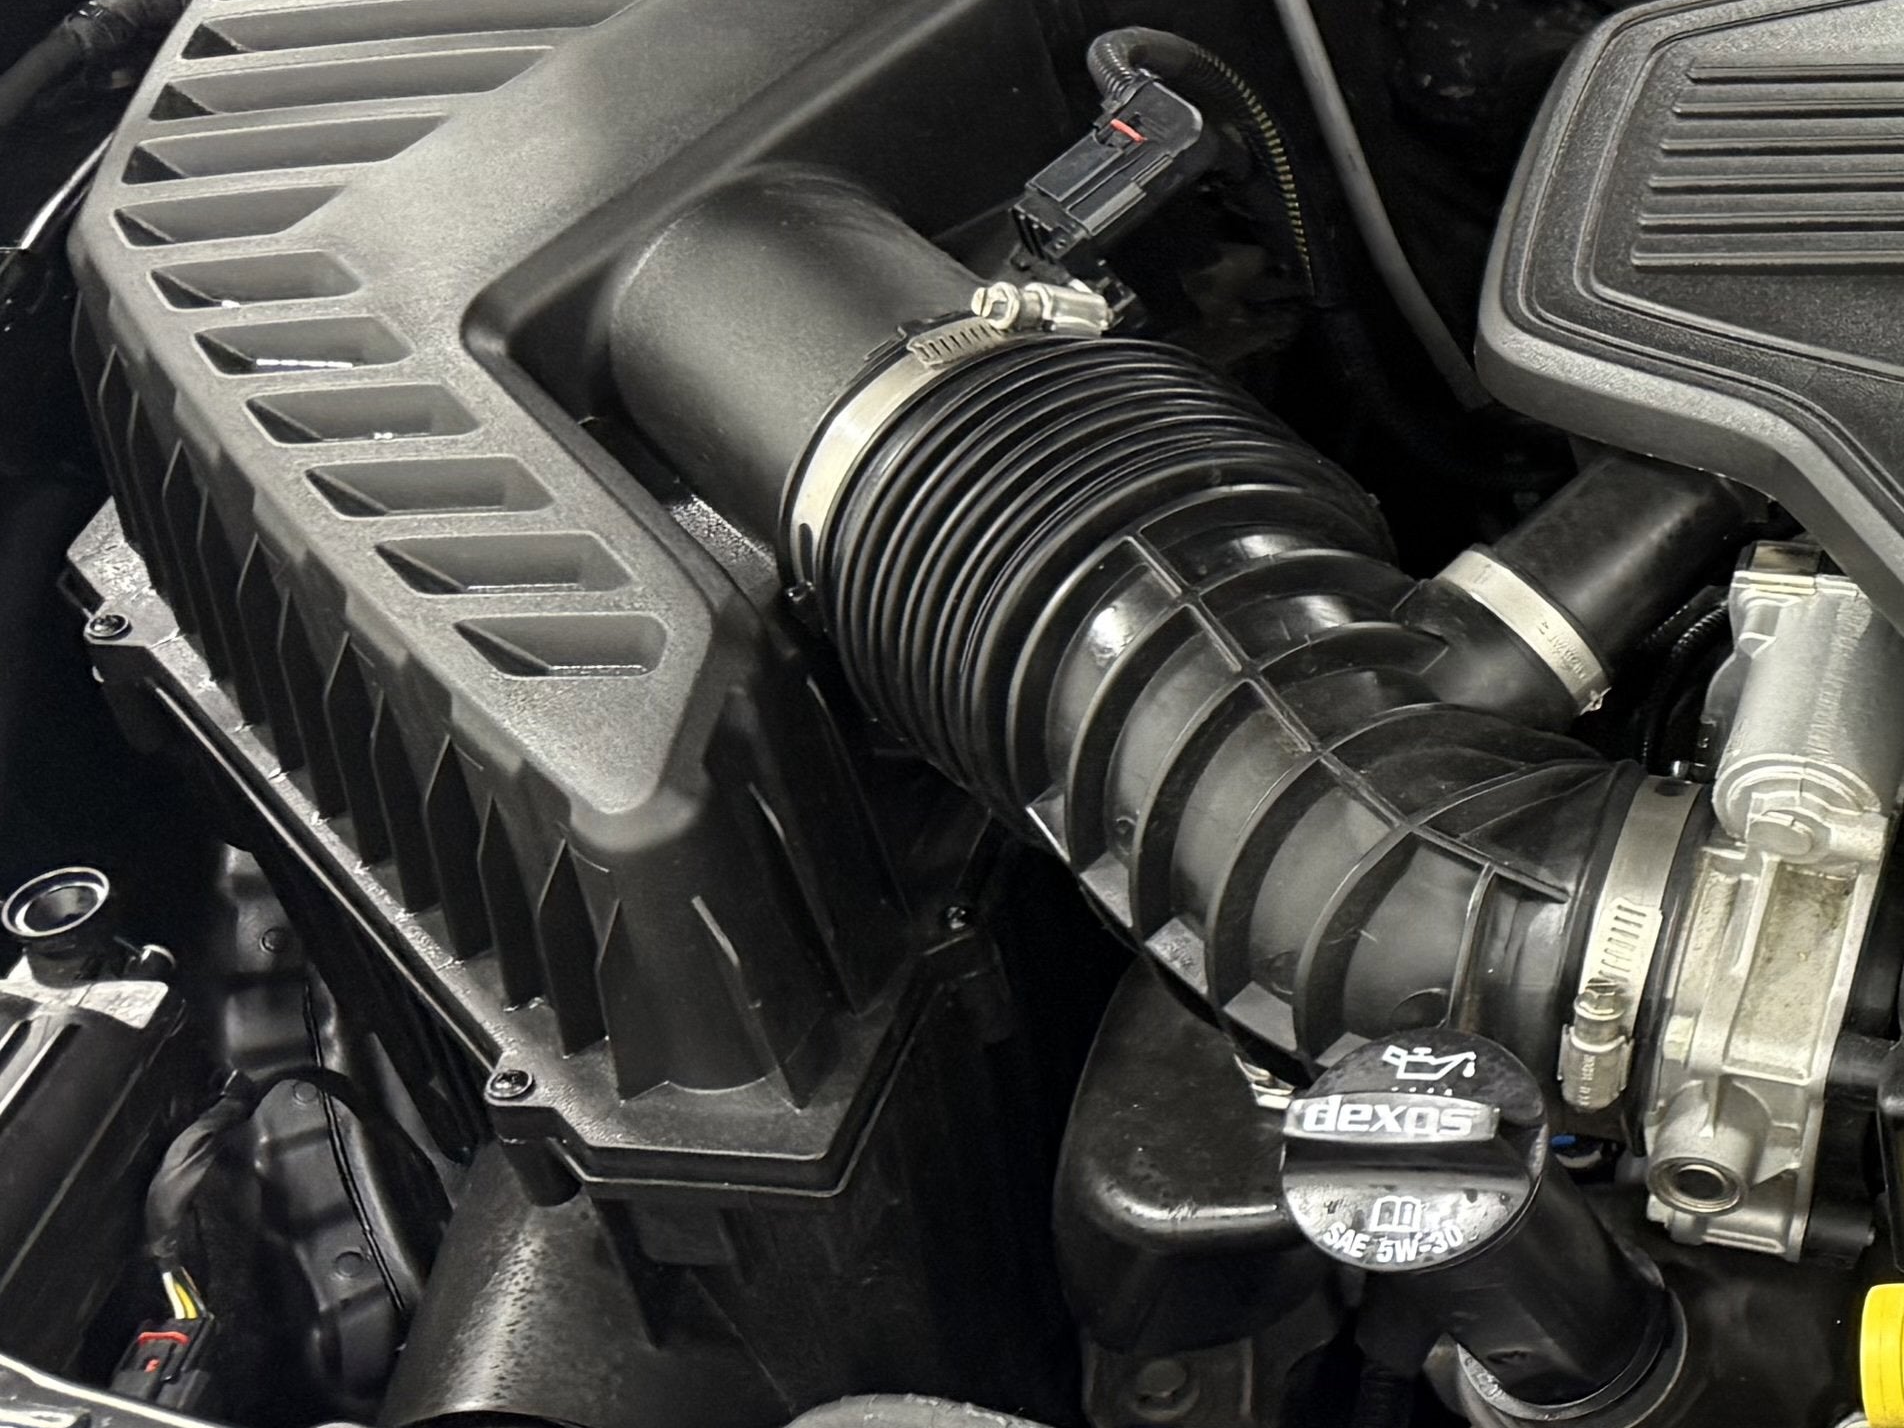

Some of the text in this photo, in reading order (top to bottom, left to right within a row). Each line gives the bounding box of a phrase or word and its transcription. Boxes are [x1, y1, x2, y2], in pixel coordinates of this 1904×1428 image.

[1302, 1094, 1473, 1139] dexos
[1323, 1222, 1464, 1262] SAE 5W-30
